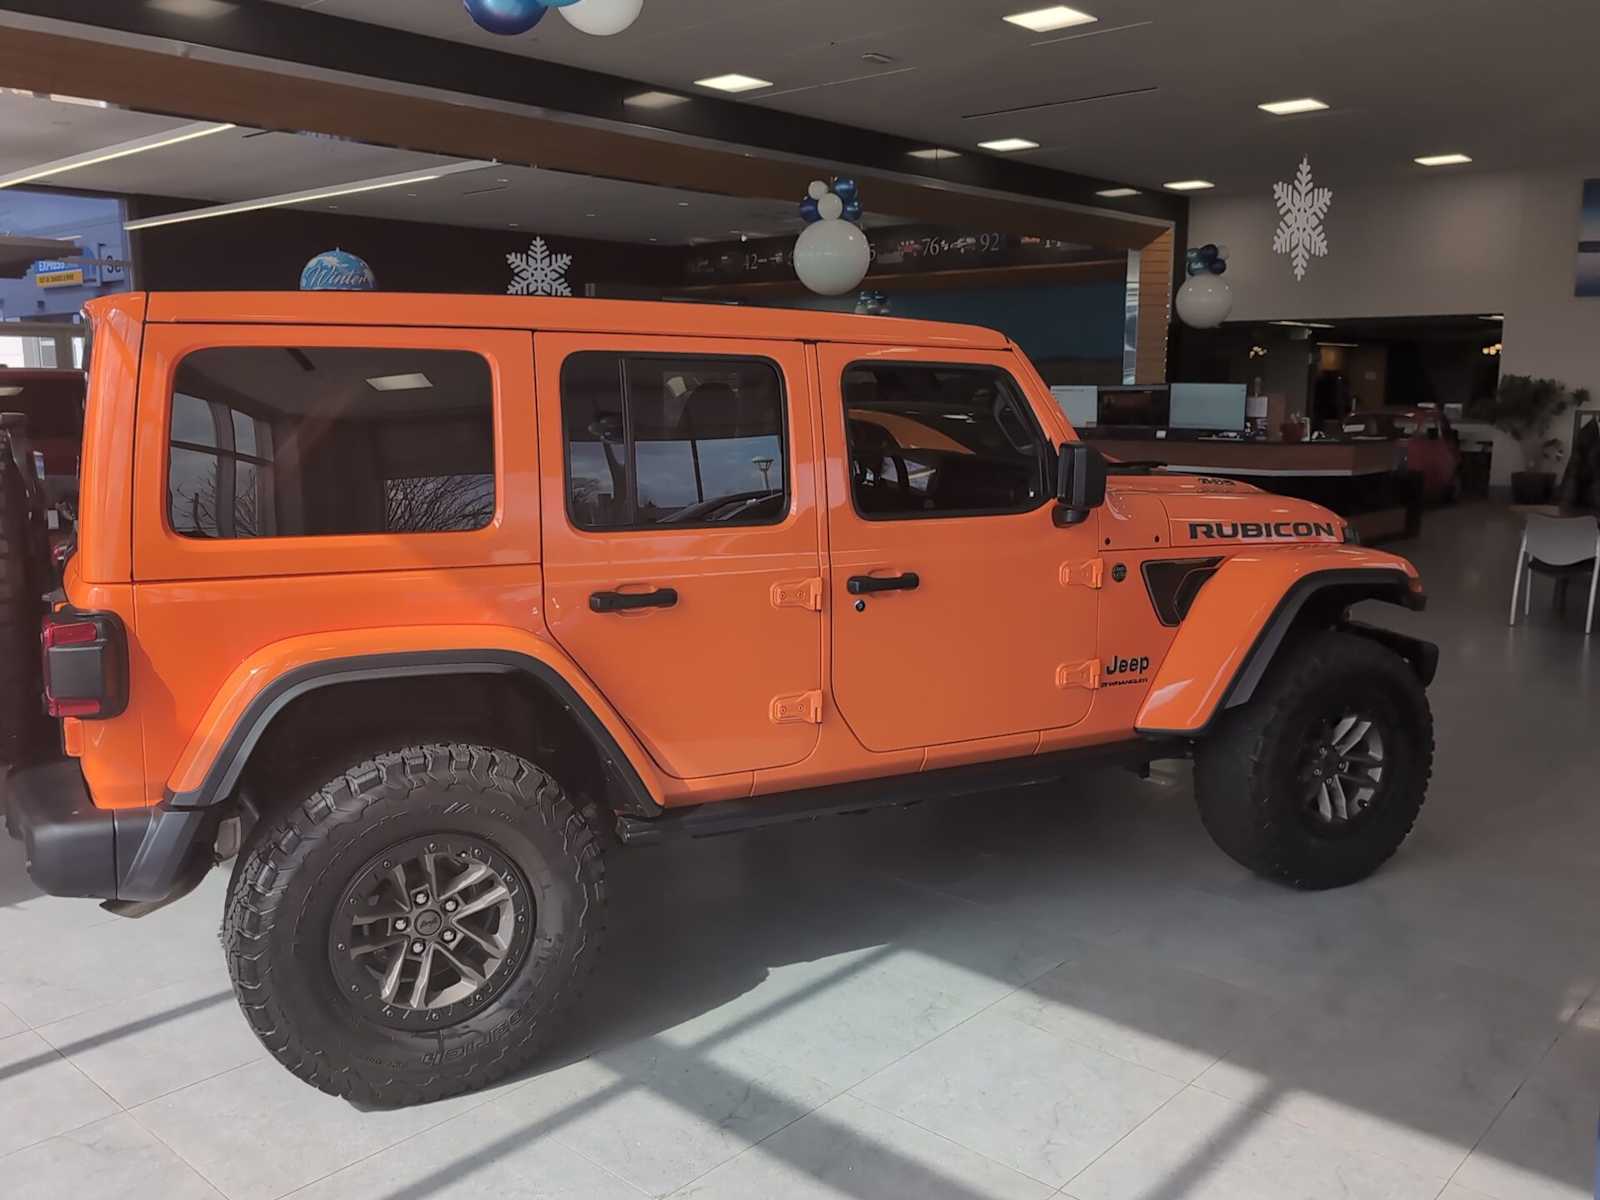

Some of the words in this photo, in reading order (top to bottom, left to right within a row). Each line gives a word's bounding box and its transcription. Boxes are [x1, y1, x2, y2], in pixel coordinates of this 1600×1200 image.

[922, 237, 940, 256] 76
[979, 232, 999, 252] 92
[1189, 521, 1335, 540] RUBICON
[1106, 655, 1150, 675] Jeep
